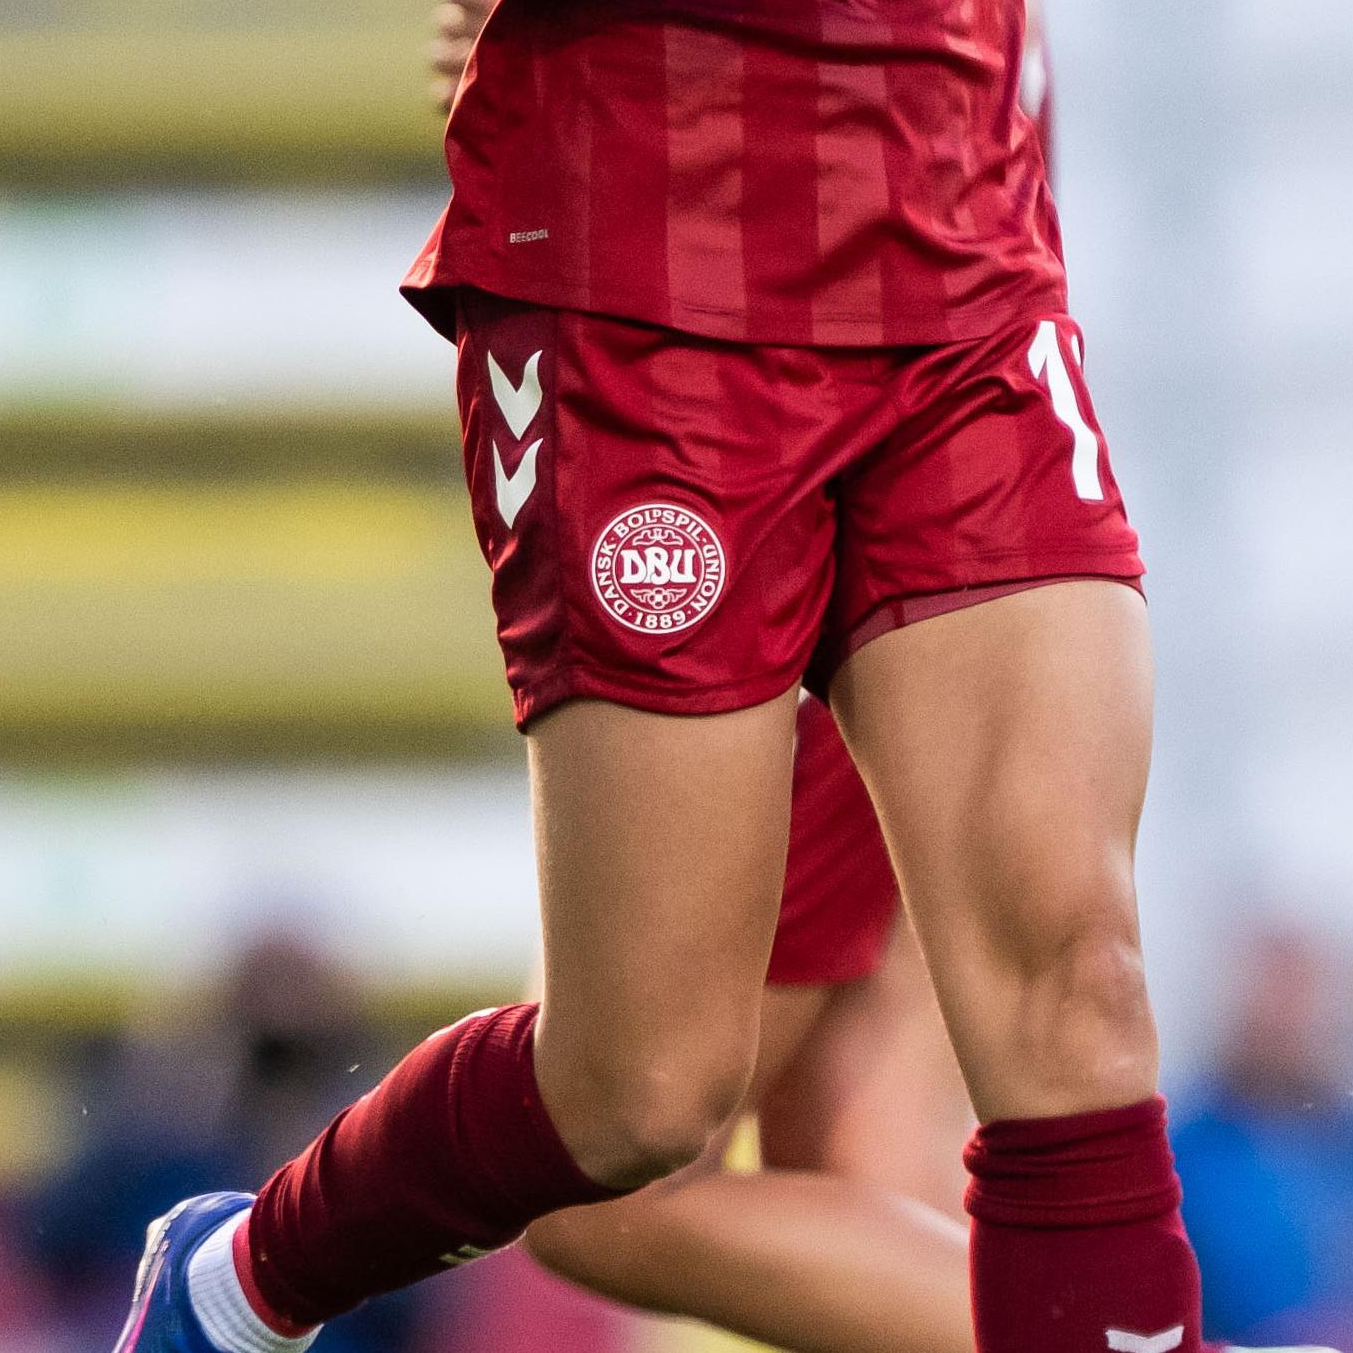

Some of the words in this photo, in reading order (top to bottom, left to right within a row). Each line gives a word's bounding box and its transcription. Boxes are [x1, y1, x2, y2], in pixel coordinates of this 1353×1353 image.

[509, 229, 549, 244] BEECOOL
[1027, 319, 1104, 501] 1
[597, 540, 629, 616] DANSK
[620, 547, 697, 585] DBU
[690, 544, 720, 613] UNION
[634, 610, 686, 629] 1889
